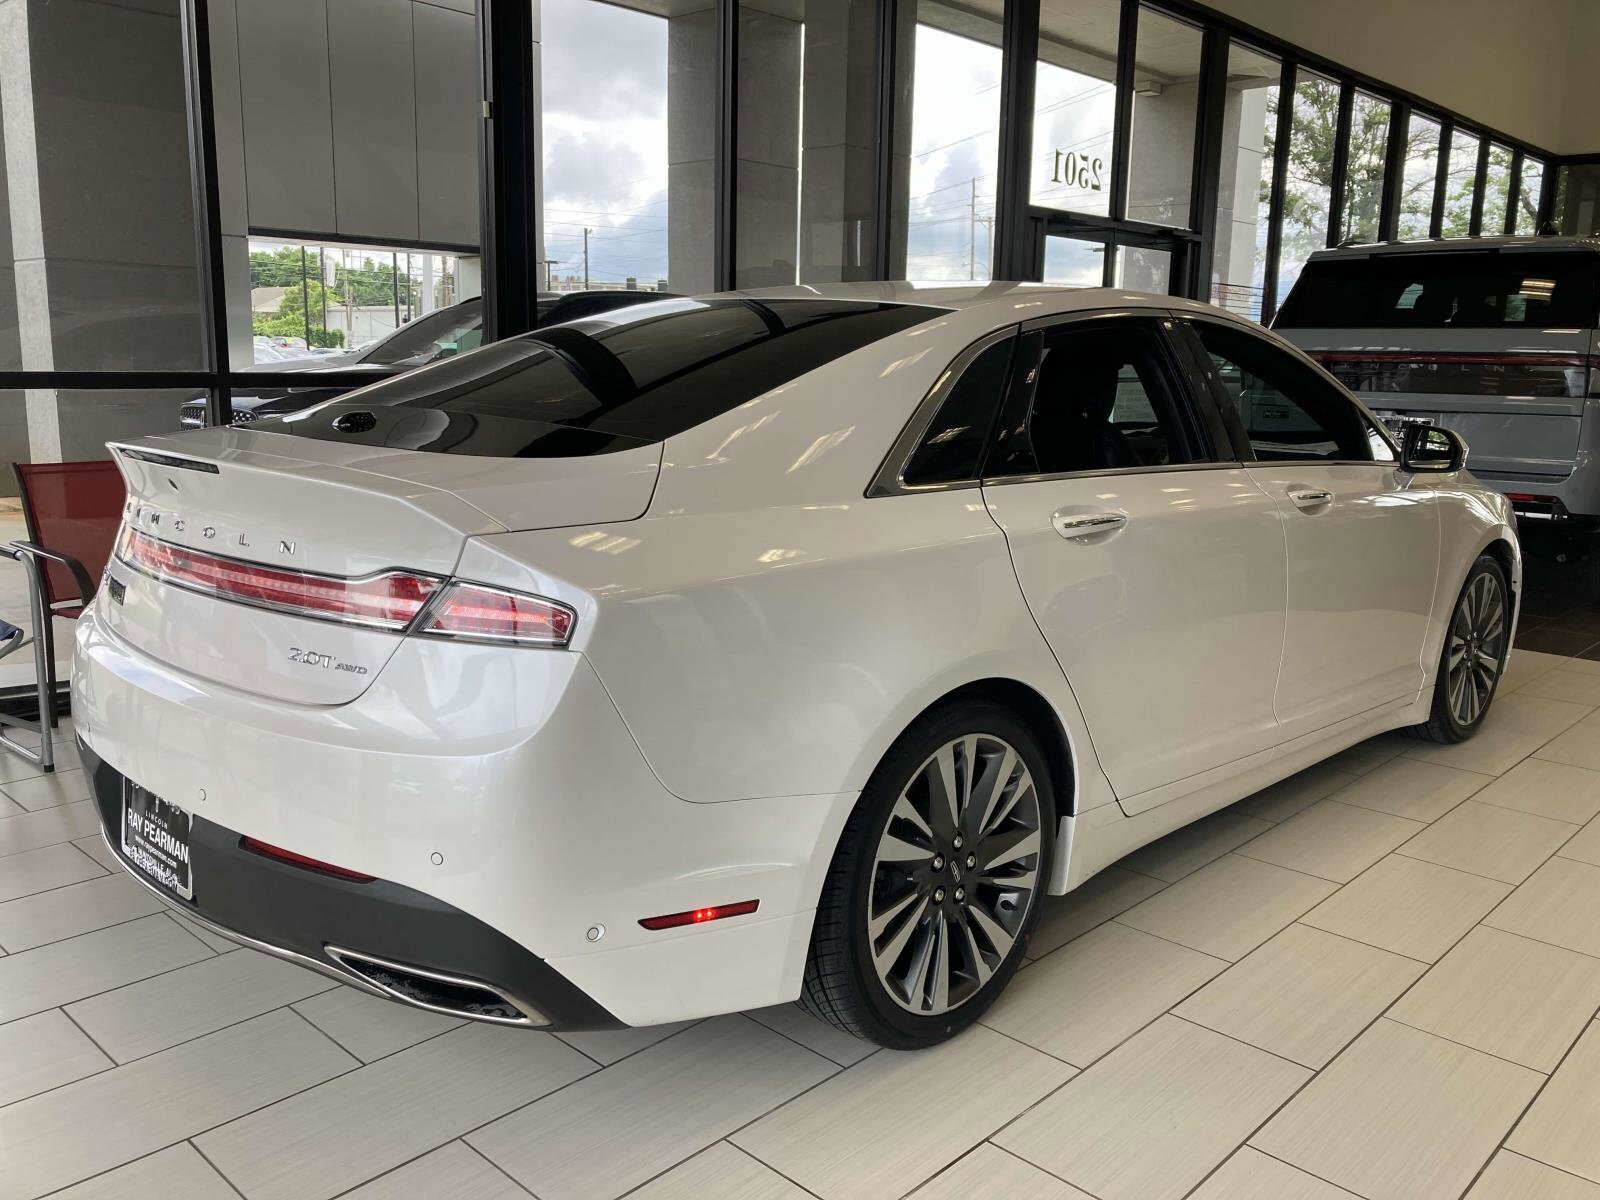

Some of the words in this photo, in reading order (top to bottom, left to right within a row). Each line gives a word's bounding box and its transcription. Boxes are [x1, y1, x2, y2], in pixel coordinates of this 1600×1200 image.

[126, 502, 296, 555] LINCOLN
[128, 807, 143, 832] RAY
[144, 819, 189, 864] PEARMAN
[145, 810, 168, 830] LINCOLN
